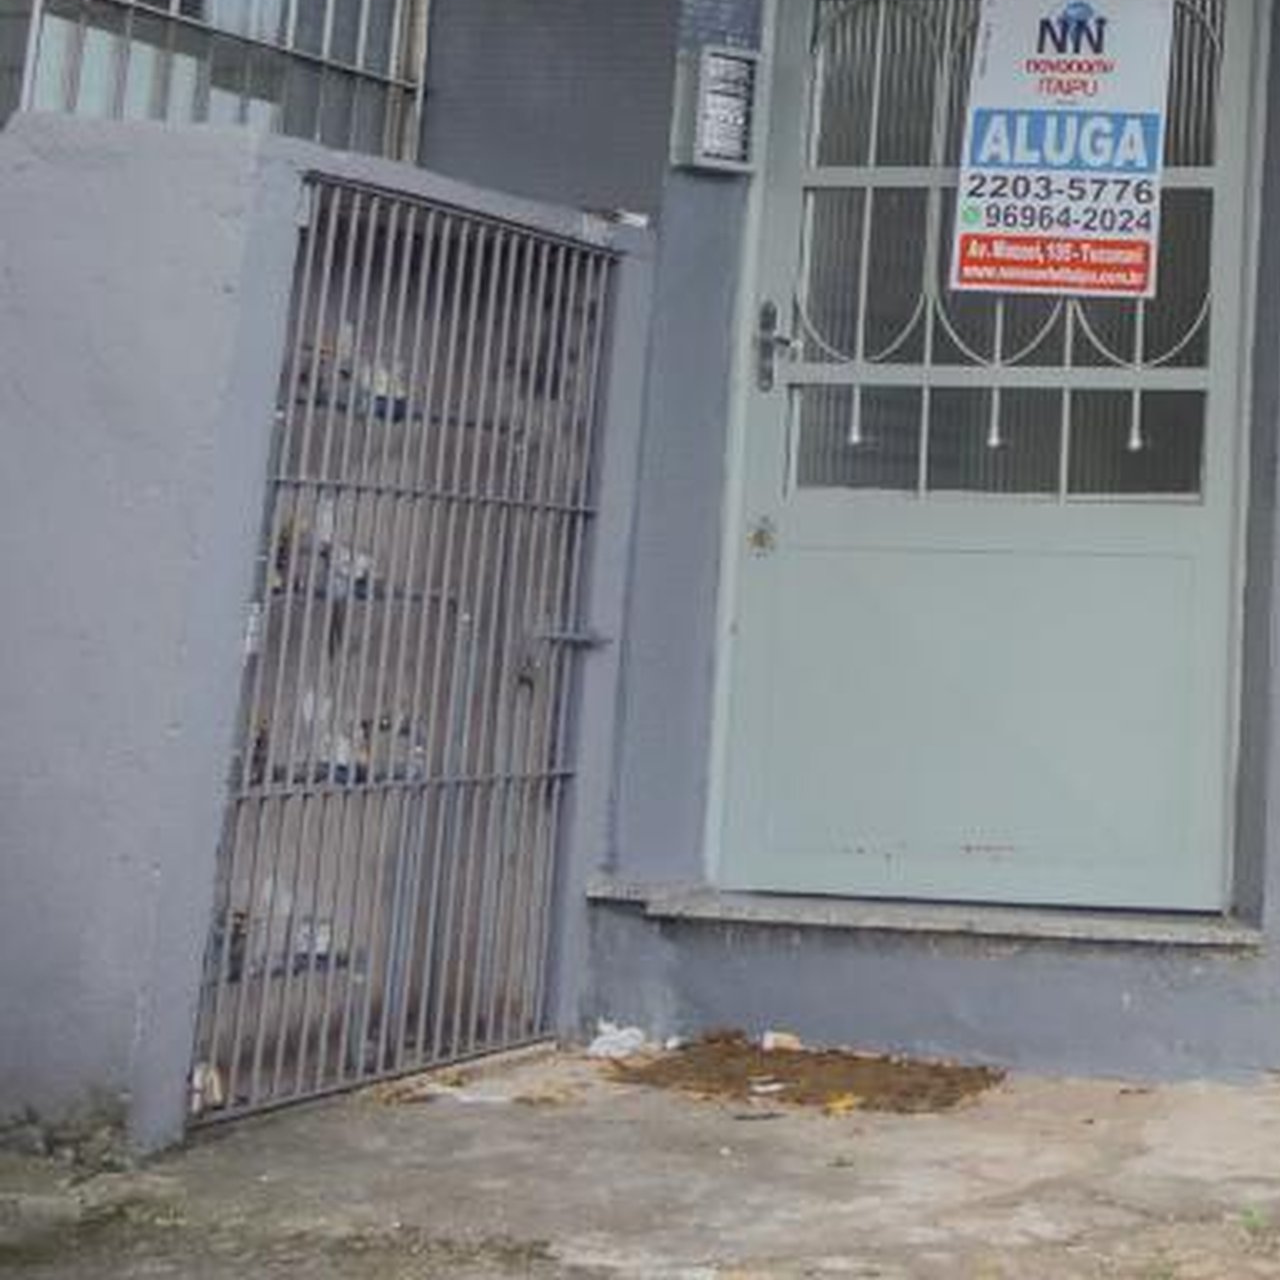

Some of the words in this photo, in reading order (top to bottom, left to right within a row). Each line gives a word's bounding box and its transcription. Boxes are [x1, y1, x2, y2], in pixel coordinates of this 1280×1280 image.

[976, 114, 1149, 167] ALUGA
[967, 173, 1154, 205] 2203-5776
[984, 205, 1152, 232] 96964-2024
